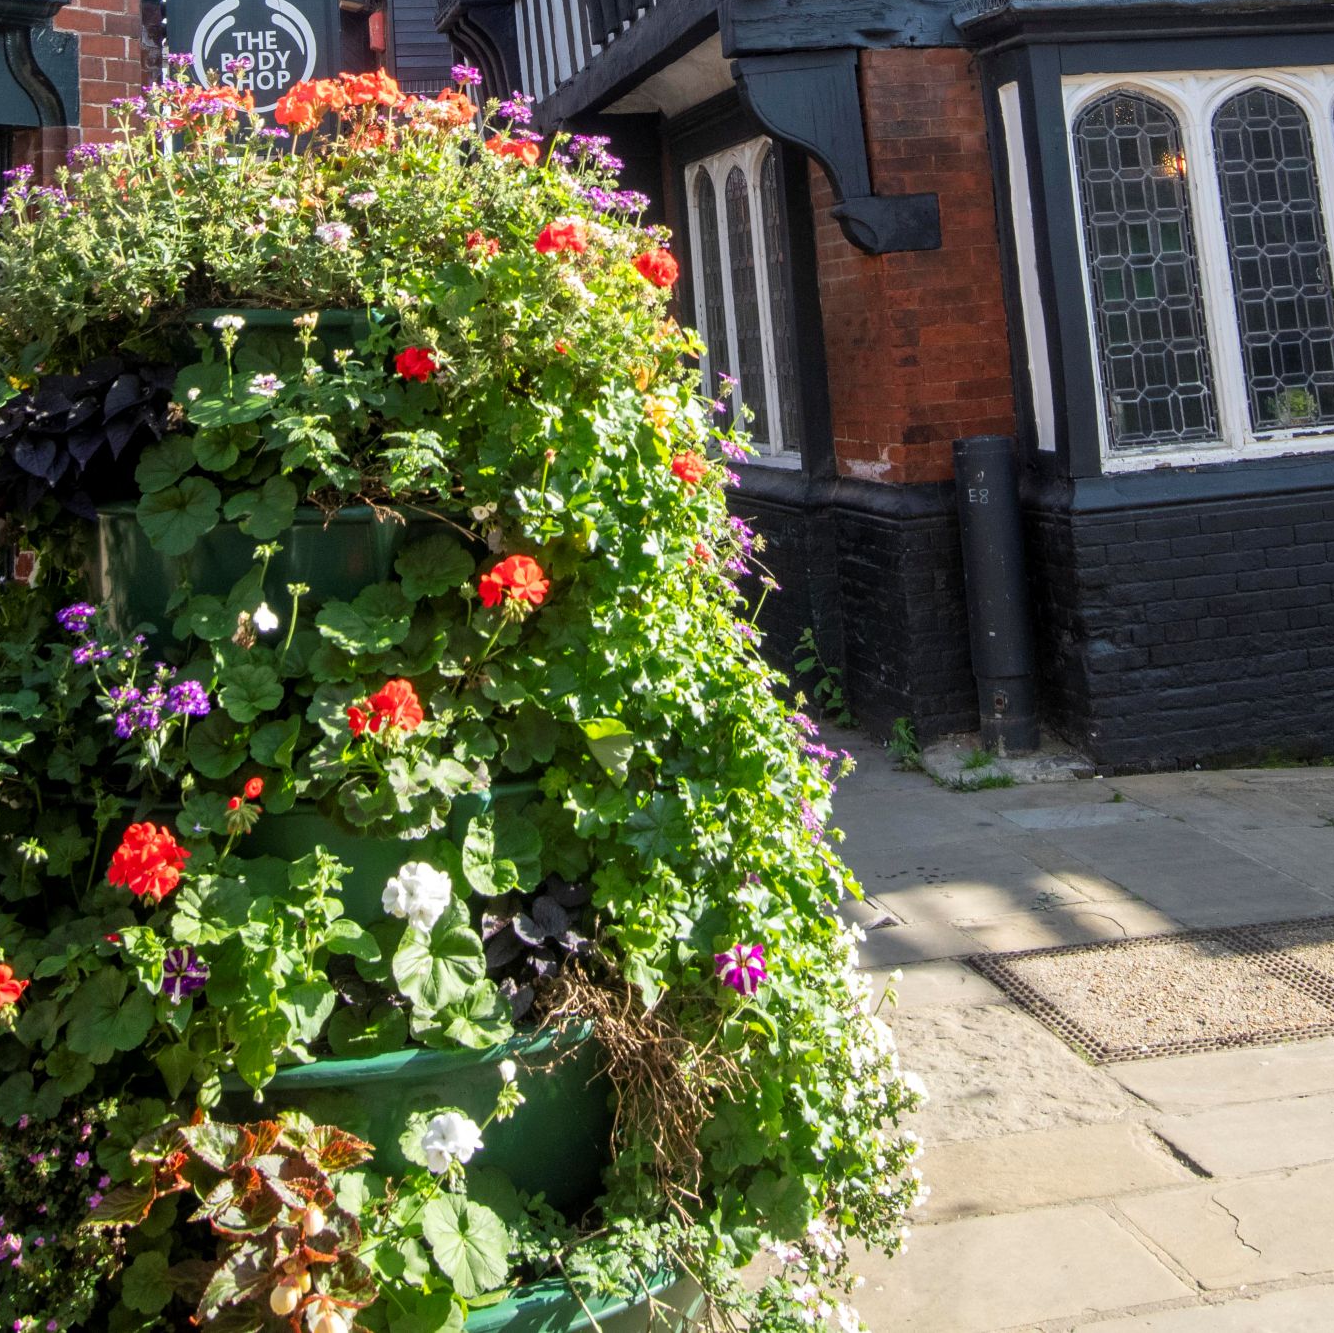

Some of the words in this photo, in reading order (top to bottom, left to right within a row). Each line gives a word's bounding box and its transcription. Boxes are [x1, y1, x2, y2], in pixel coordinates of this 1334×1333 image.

[232, 31, 278, 51] THE
[221, 50, 291, 72] BODY
[221, 70, 291, 91] SHOP
[968, 488, 989, 504] E8
